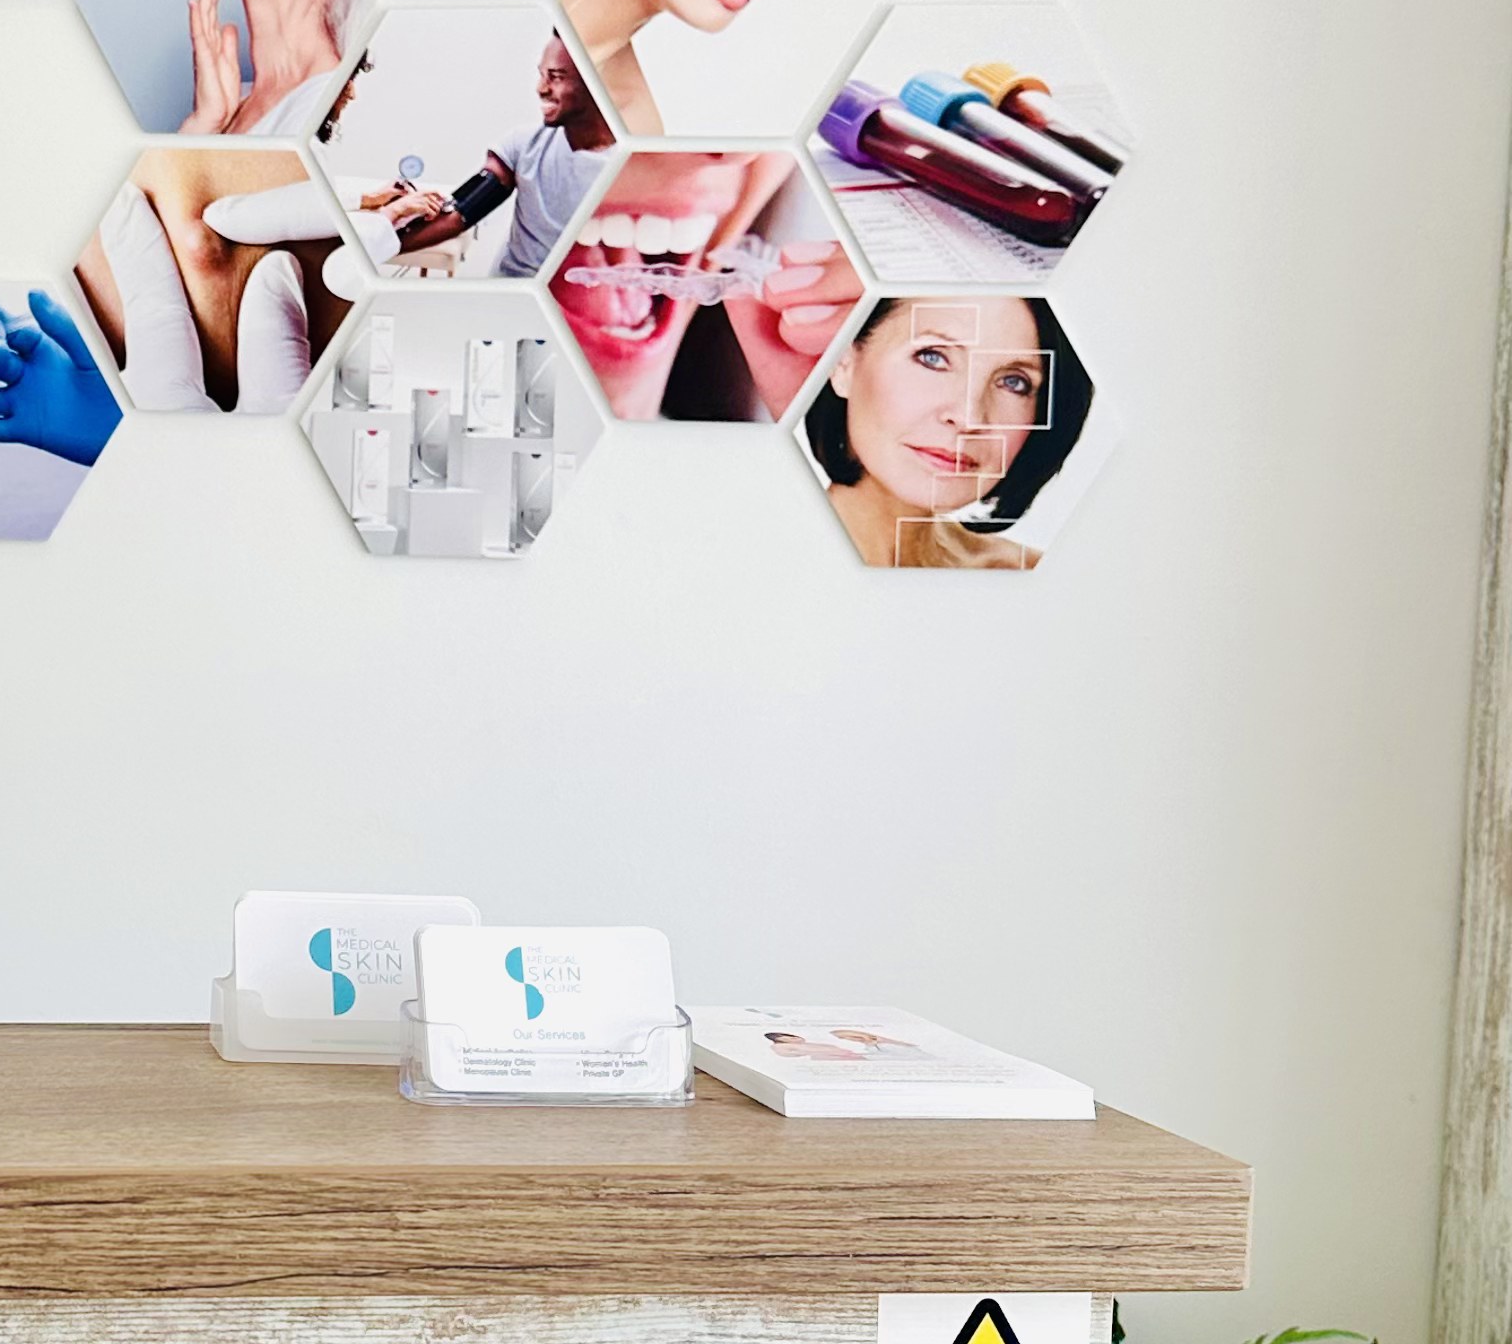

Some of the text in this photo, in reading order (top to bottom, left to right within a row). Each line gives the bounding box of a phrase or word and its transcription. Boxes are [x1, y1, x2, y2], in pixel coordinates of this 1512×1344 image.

[336, 928, 357, 936] THE
[336, 939, 400, 951] MEDICAL
[337, 952, 402, 971] SKIN
[357, 973, 403, 985] CLINIC
[528, 966, 581, 982] SKIN
[545, 984, 581, 993] CLINIC
[513, 1028, 585, 1040] Our Services
[514, 1058, 536, 1067] Clinic
